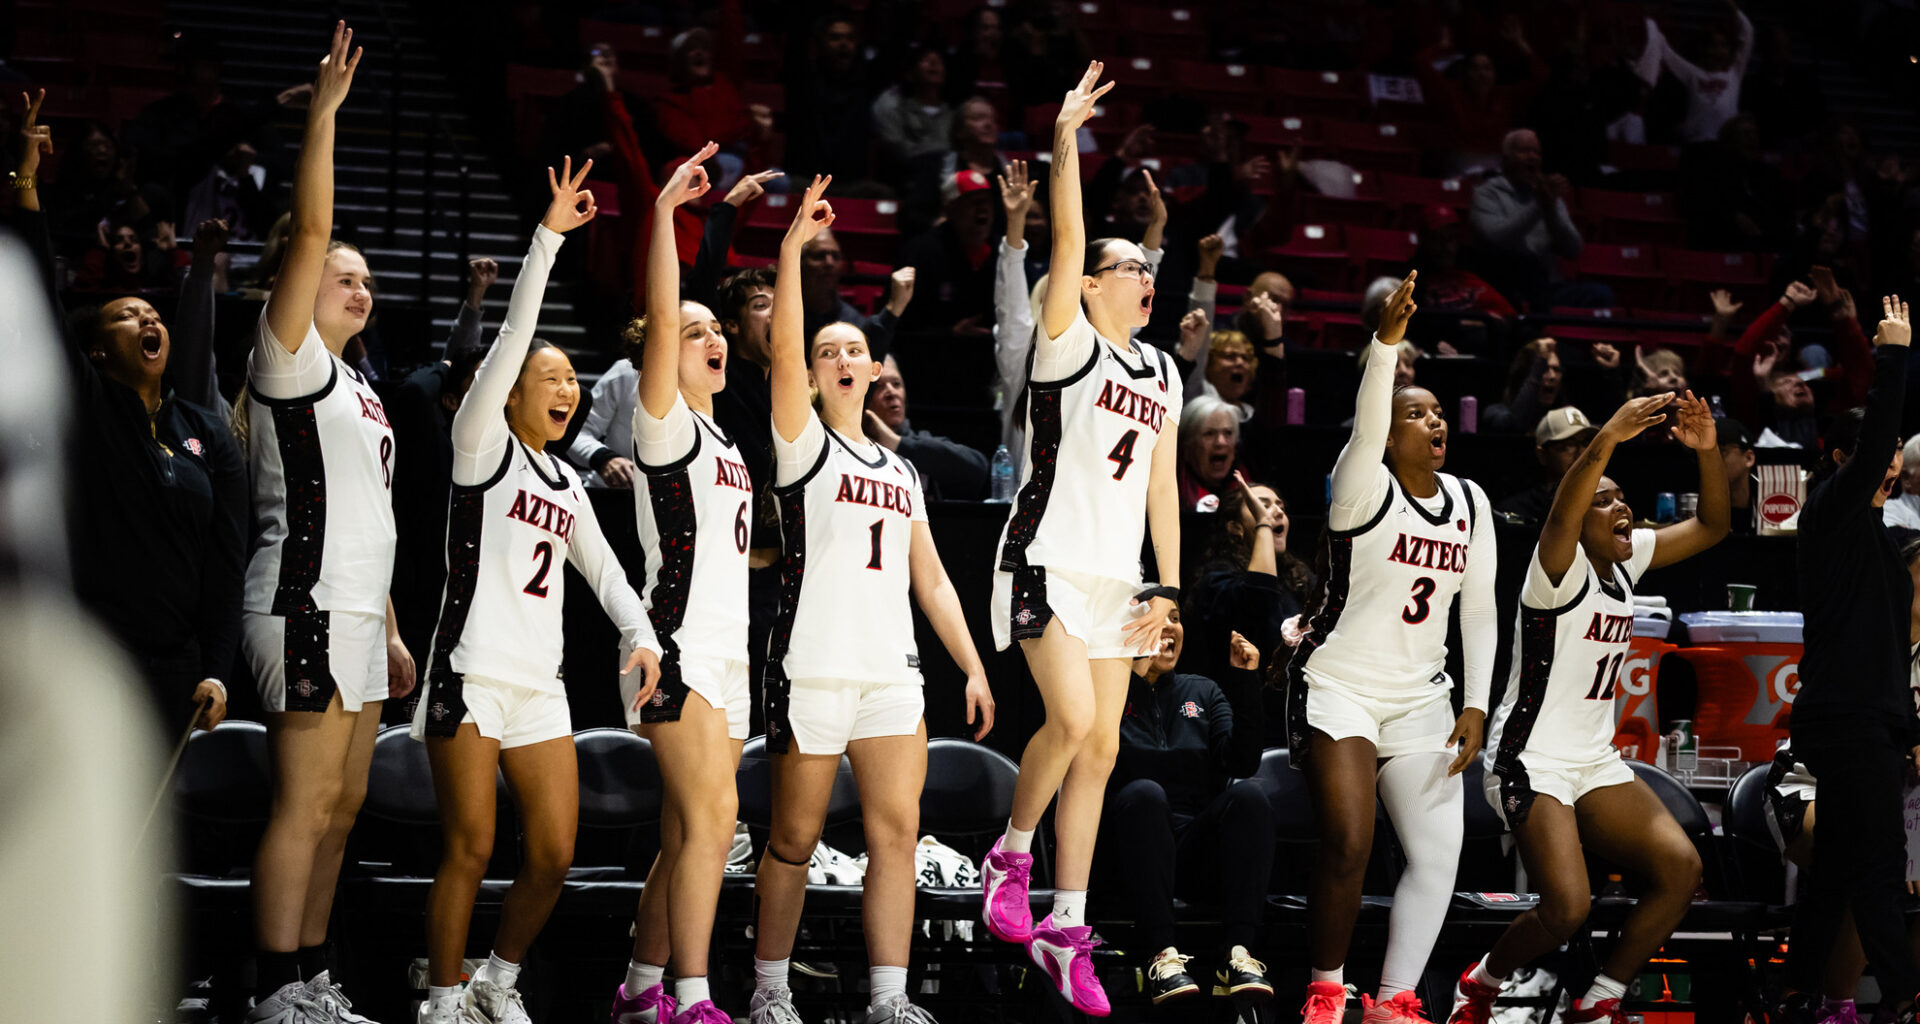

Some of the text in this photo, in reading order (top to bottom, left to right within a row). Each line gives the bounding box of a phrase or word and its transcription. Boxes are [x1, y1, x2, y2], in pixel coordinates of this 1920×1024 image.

[1095, 379, 1167, 434] AZTECS
[380, 435, 392, 490] 8
[1107, 429, 1139, 481] 4
[835, 473, 912, 518] AZTECS
[1764, 503, 1796, 514] POPCORN
[735, 500, 748, 554] 6
[866, 518, 884, 571] 1
[523, 541, 553, 599] 2
[1388, 533, 1468, 573] AZTECS
[1402, 577, 1436, 625] 3
[1584, 652, 1624, 701] 12
[1620, 658, 1651, 697] G
